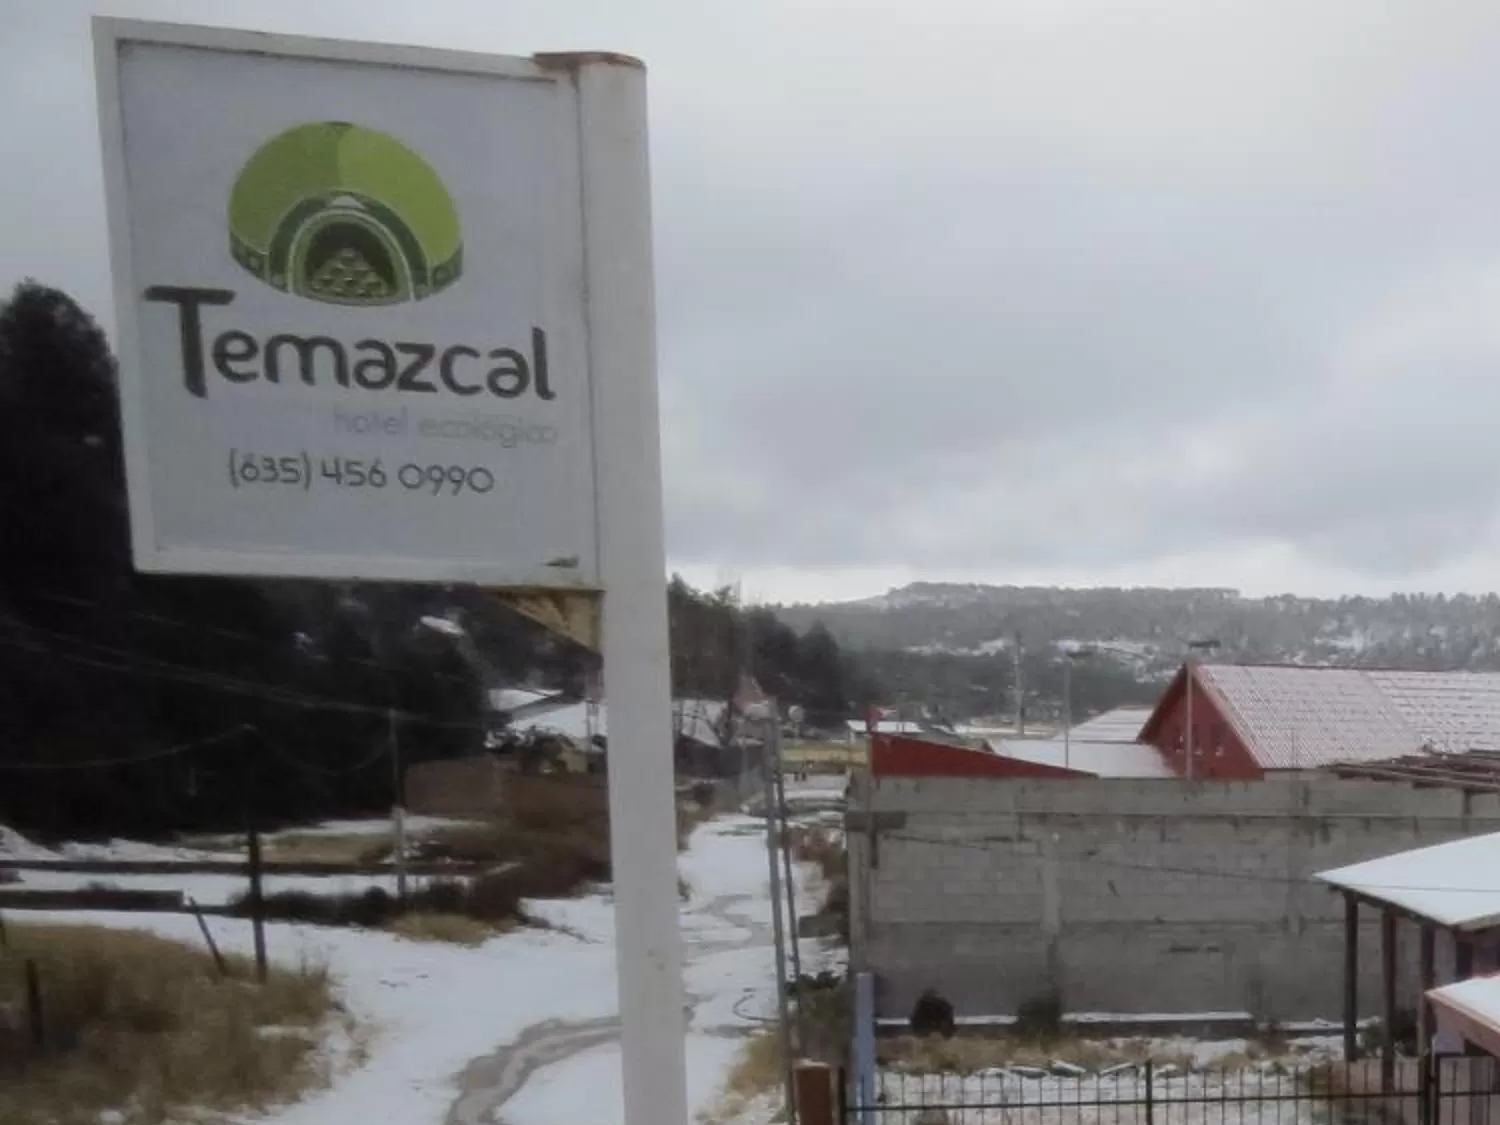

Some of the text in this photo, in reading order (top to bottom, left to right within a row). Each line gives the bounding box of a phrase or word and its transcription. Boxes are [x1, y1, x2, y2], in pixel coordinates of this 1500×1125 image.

[143, 285, 557, 401] Temazcal
[333, 403, 408, 436] hotel
[229, 447, 495, 497] (635) 456 0990
